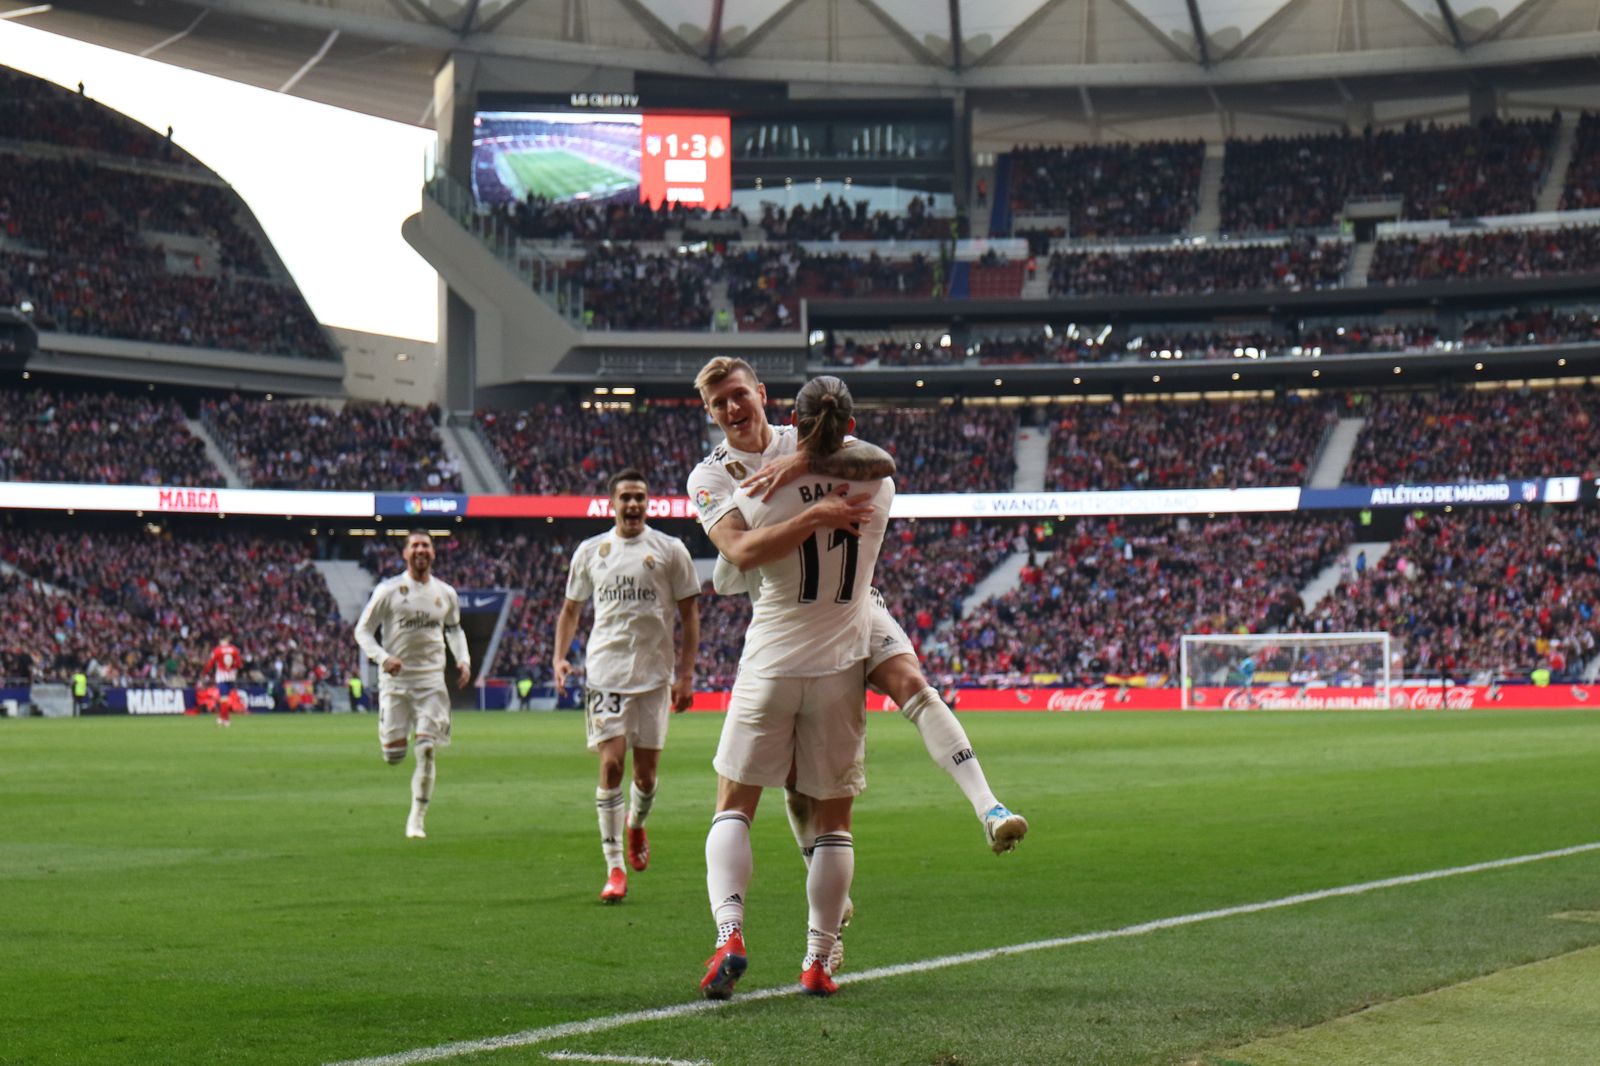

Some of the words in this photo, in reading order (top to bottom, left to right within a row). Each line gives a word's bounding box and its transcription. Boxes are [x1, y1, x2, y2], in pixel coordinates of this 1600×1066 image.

[159, 489, 219, 510] MARCA
[798, 482, 848, 504] BAL
[1434, 486, 1453, 502] DE
[1453, 484, 1509, 501] MADRID
[992, 498, 1059, 511] WANDA
[615, 575, 634, 588] Fly
[598, 586, 657, 601] Emirates
[126, 689, 186, 714] MARCA
[593, 692, 620, 714] 23
